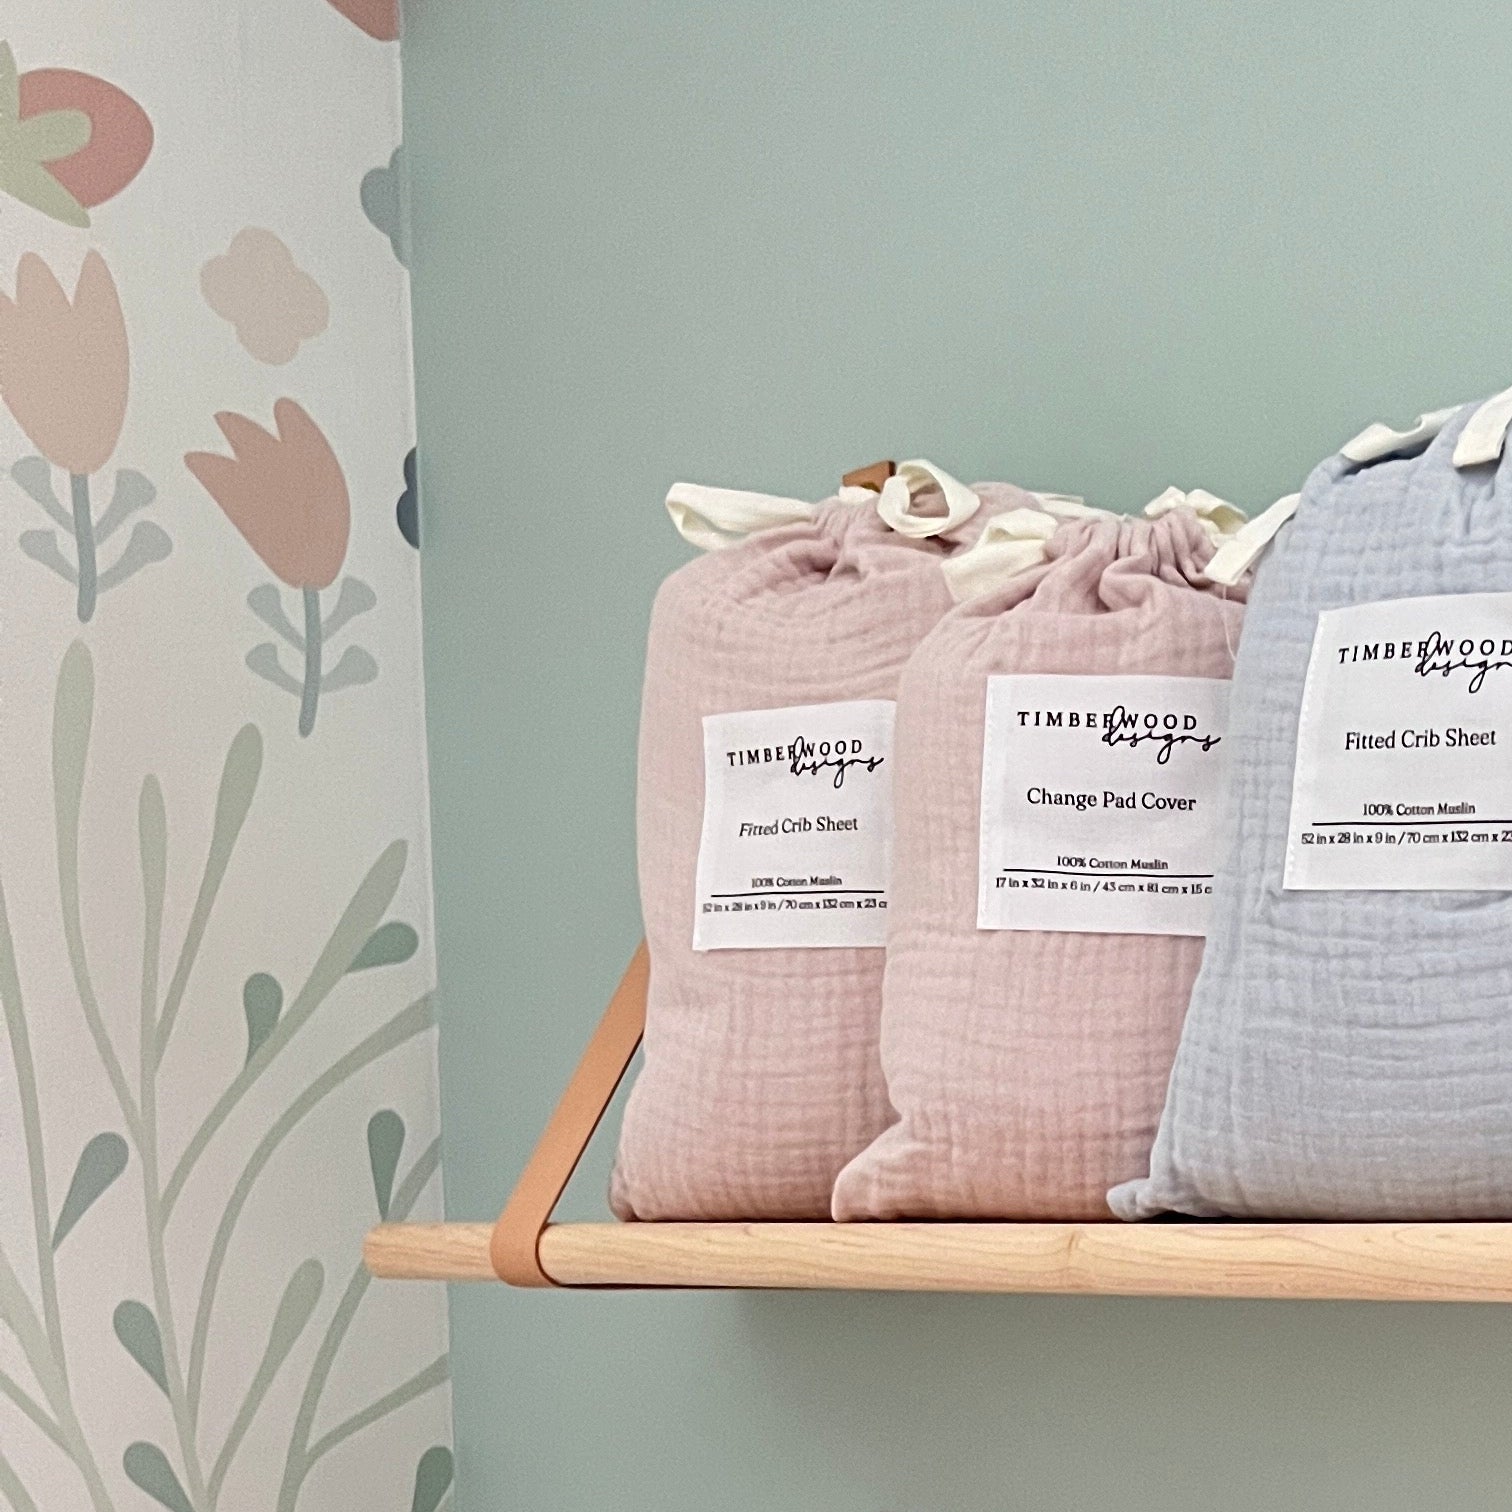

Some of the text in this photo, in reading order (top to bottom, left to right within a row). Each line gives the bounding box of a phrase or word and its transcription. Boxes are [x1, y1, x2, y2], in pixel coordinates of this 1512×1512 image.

[1102, 706, 1221, 764] designs
[1345, 728, 1496, 750] Fitted Crib Sheet
[790, 736, 884, 788] designs
[1027, 788, 1196, 811] Change Pad Cover
[1364, 802, 1475, 816] 100% Cotton Muslin
[739, 817, 858, 837] Fitted Crib Sheet
[1316, 832, 1327, 845] in
[1328, 835, 1336, 845] x
[1337, 831, 1351, 844] 28
[1352, 831, 1364, 844] in
[1366, 834, 1374, 844] x
[1374, 831, 1384, 844] 9
[1384, 832, 1397, 844] in
[1406, 831, 1421, 844] 70
[1422, 834, 1440, 844] cm
[1441, 833, 1449, 843] x
[1450, 830, 1469, 843] 132
[1470, 833, 1490, 843] cm
[1491, 833, 1499, 843] x
[1058, 856, 1168, 869] 100% Cotton Muslin
